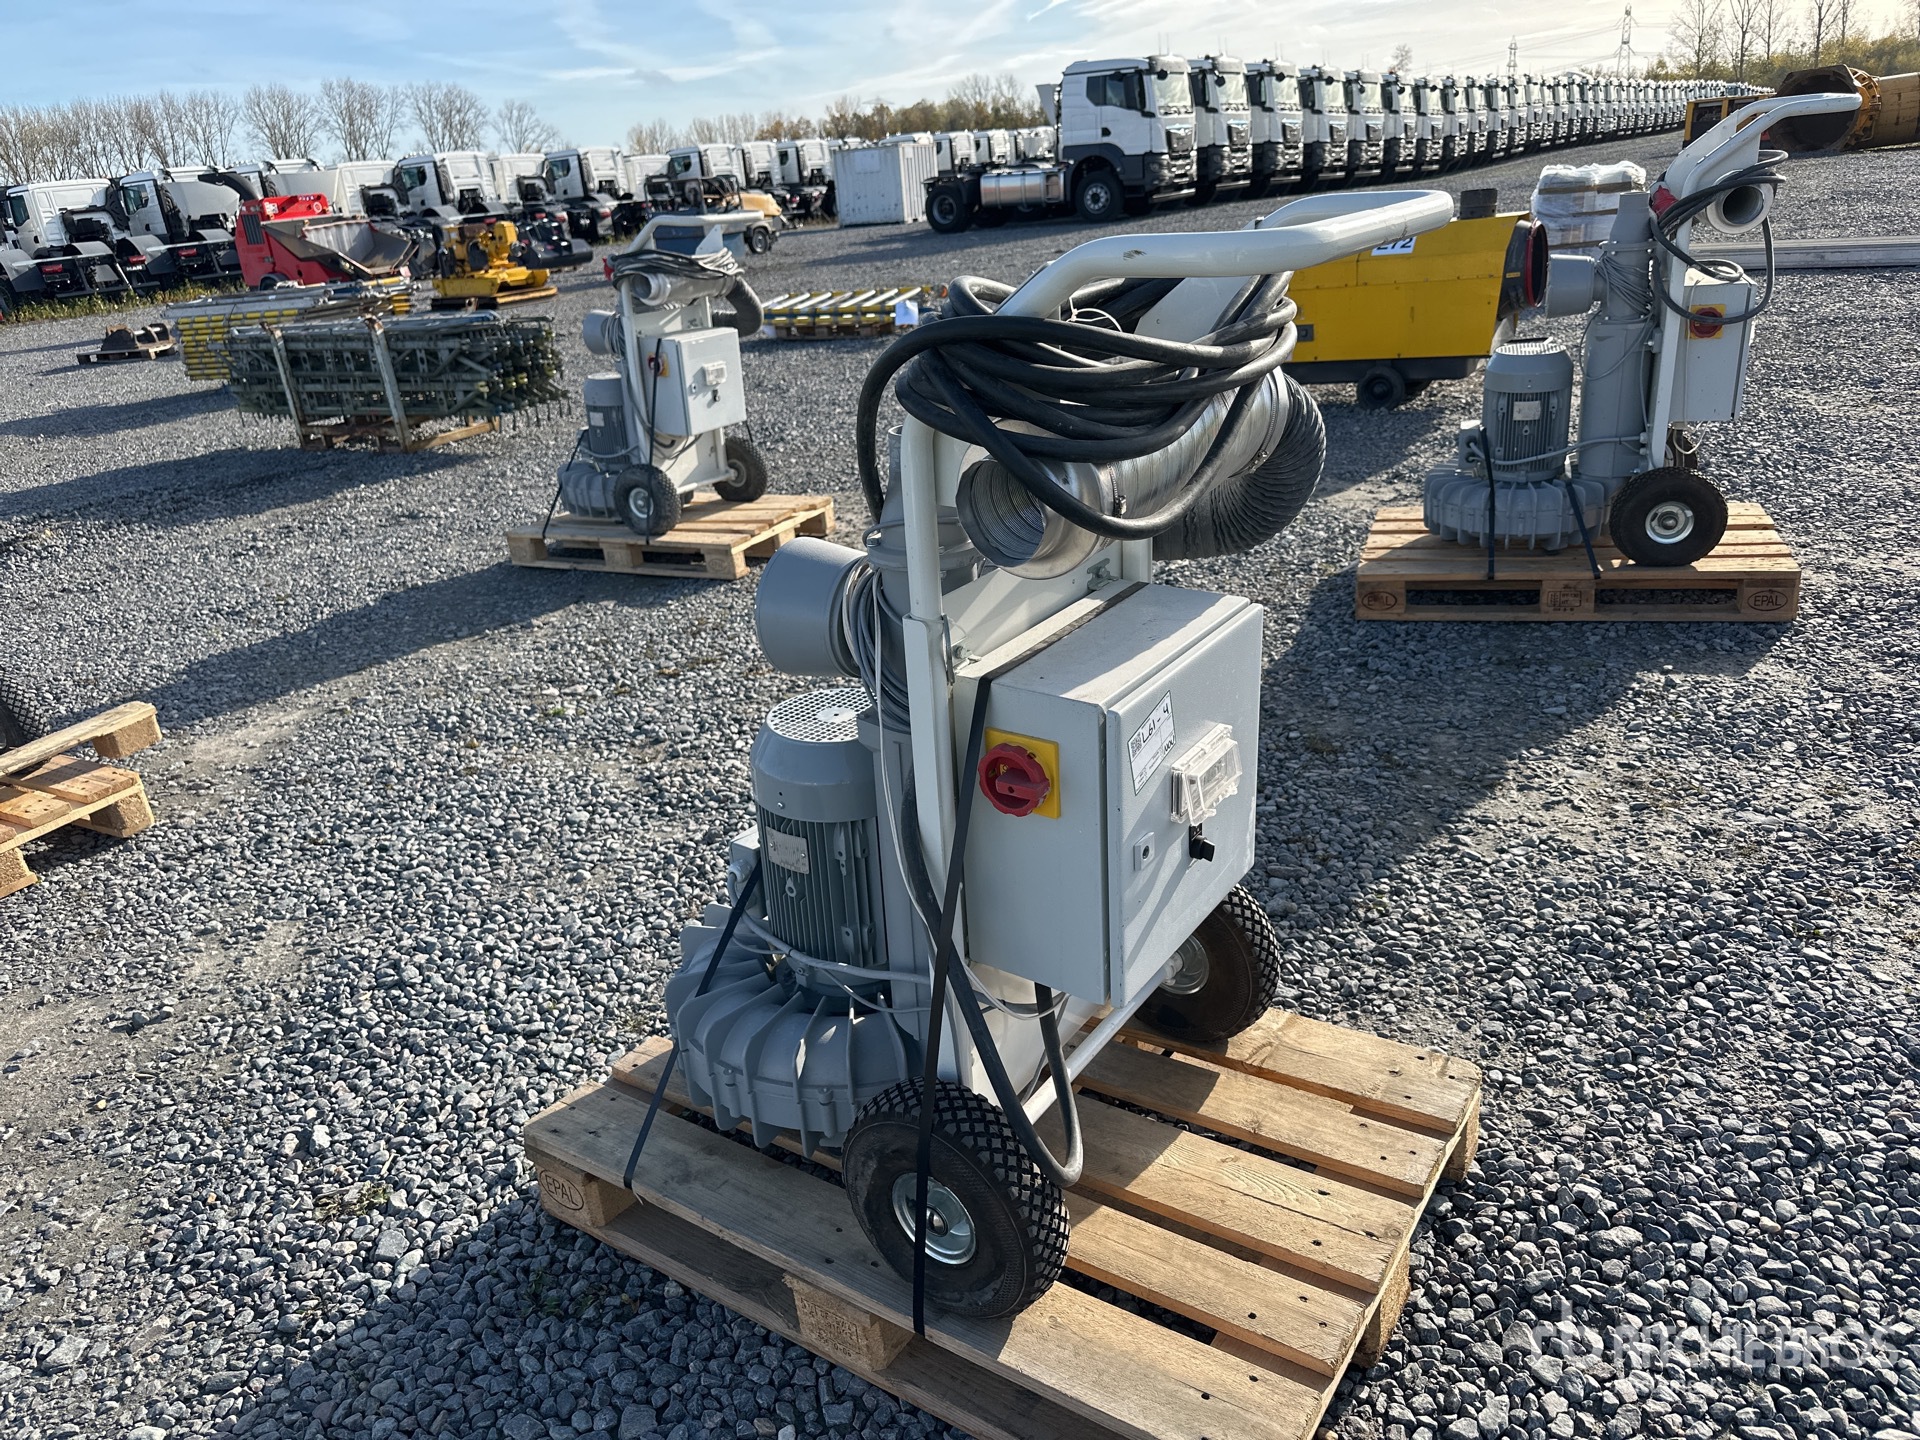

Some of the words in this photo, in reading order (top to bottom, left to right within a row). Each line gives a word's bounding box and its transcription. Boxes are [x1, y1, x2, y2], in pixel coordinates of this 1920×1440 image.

[1376, 237, 1413, 250] 72
[1753, 595, 1782, 607] EPAL
[545, 1174, 579, 1207] EPAL
